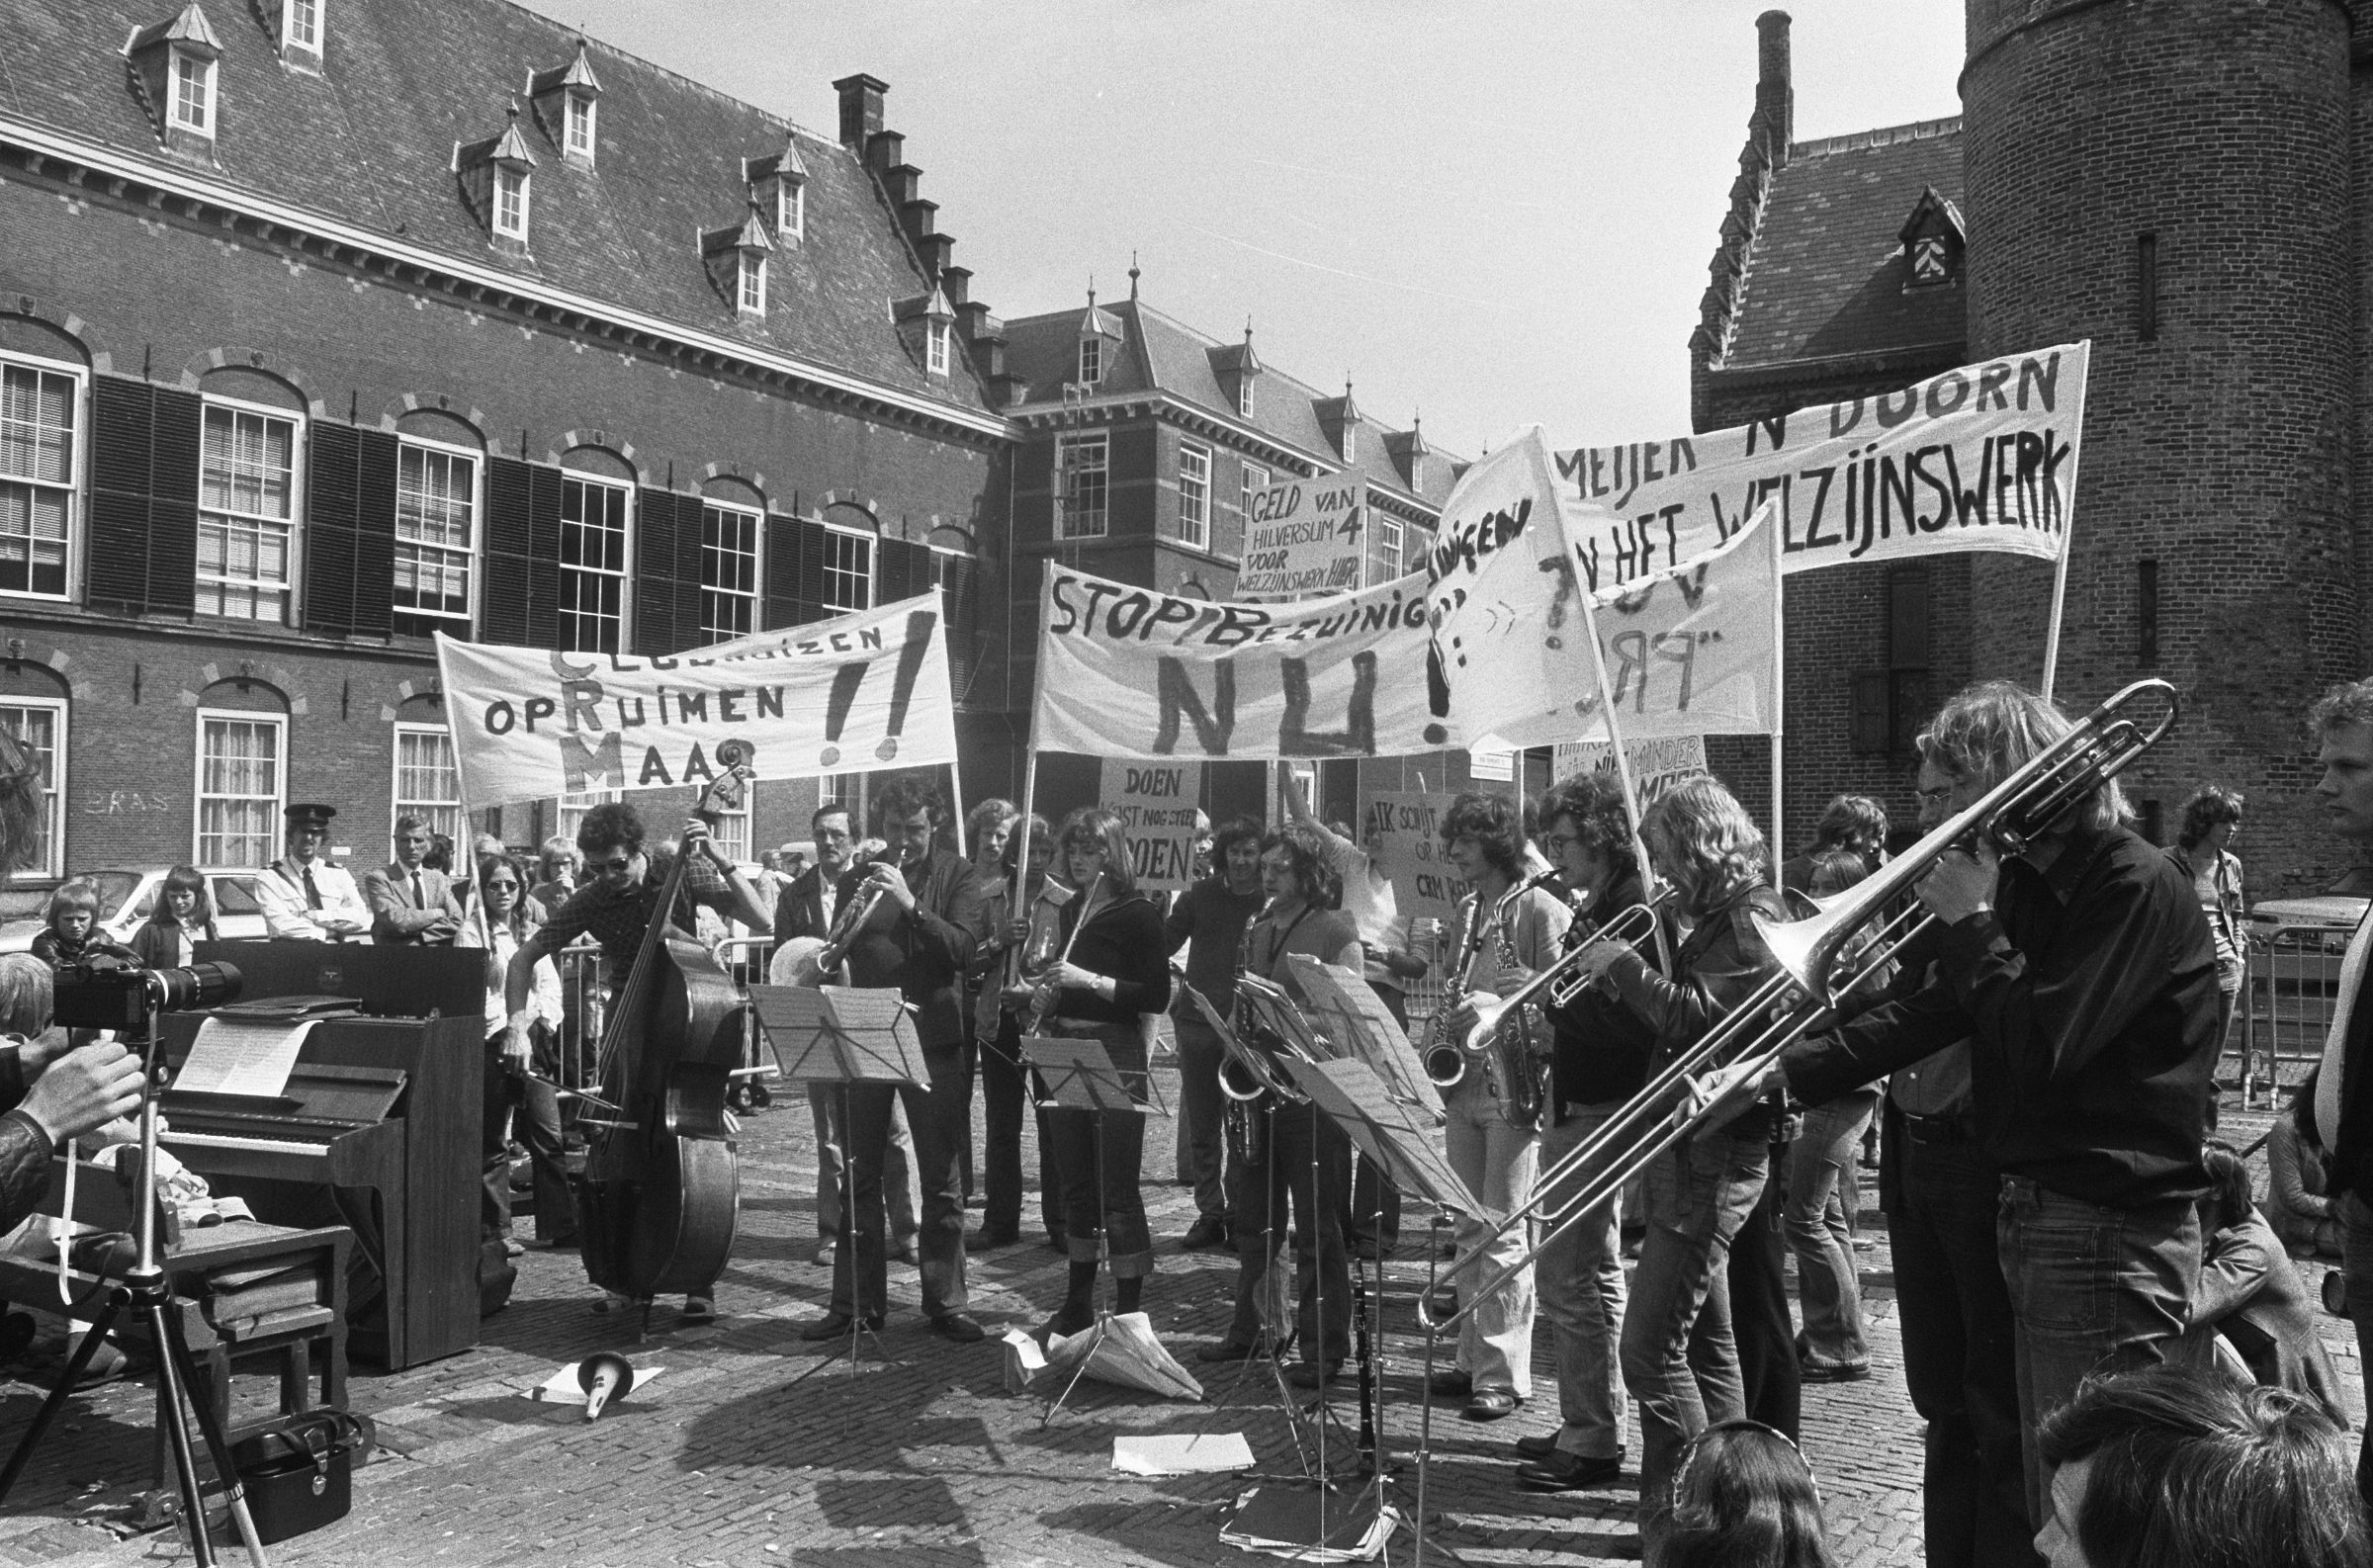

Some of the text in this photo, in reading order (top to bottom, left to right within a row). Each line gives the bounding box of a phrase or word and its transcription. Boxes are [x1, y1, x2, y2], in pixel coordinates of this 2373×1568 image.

[1252, 484, 1356, 523] GELD VAN
[1253, 505, 1363, 551] HILVERSUM 4
[1247, 549, 1288, 570] VOOR
[1628, 735, 1703, 778] MINDER
[1123, 767, 1183, 797] DOEN
[1142, 808, 1168, 827] NOG
[1375, 801, 1396, 832] IK
[1415, 841, 1432, 861] OP
[1416, 873, 1446, 901] CRM
